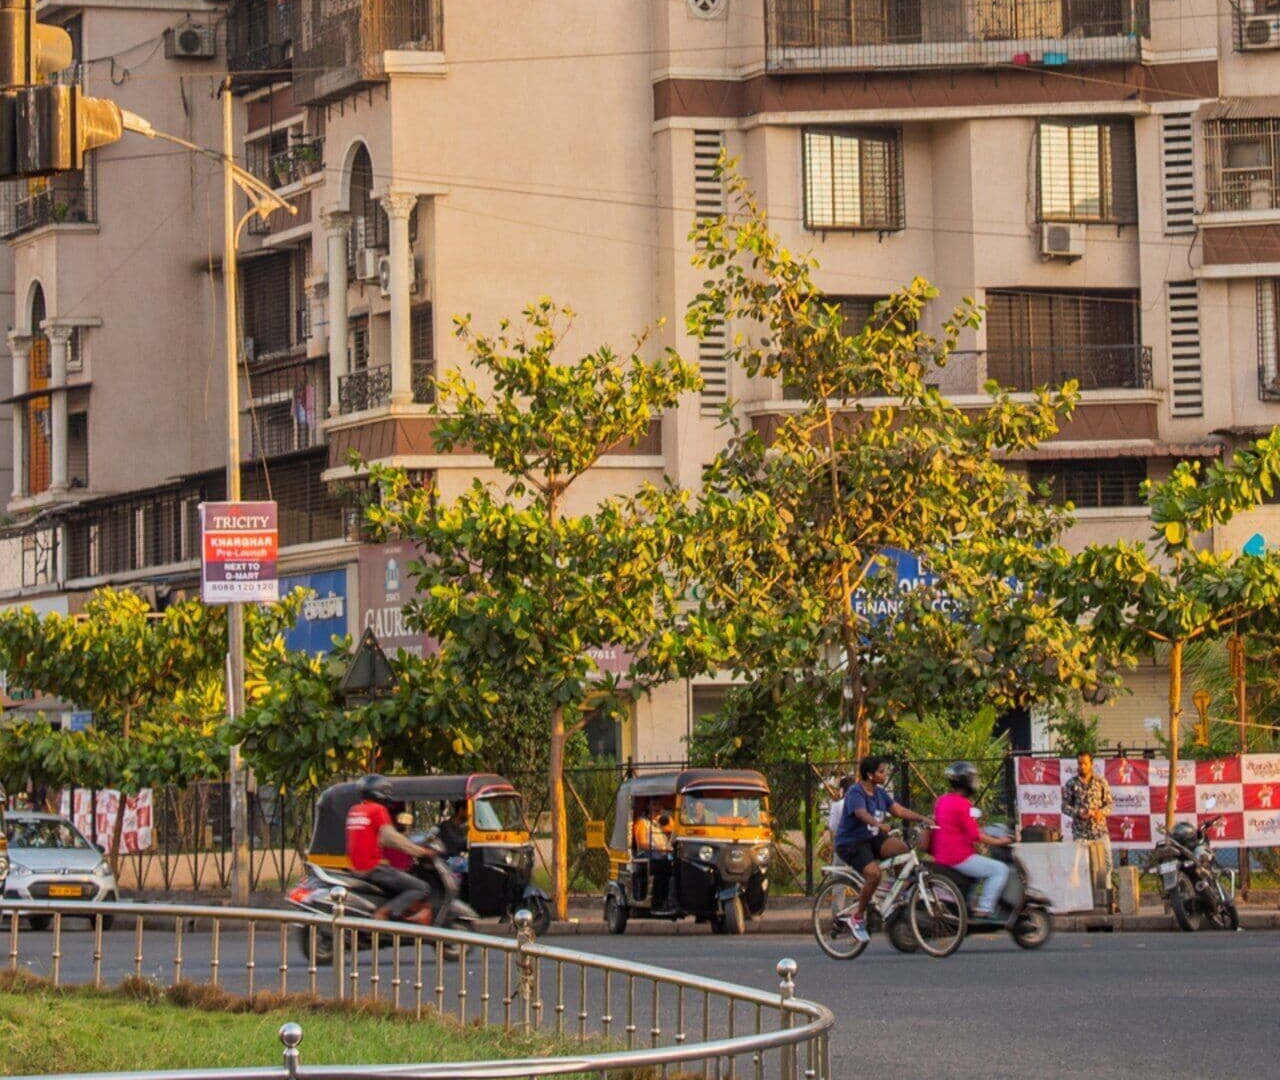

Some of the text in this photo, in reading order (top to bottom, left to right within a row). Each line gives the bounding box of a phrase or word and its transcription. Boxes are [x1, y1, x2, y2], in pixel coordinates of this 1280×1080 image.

[213, 515, 270, 529] TRICITY
[210, 536, 272, 547] KHARGHAR
[224, 562, 260, 571] NEXT TO
[225, 572, 260, 580] D-MART
